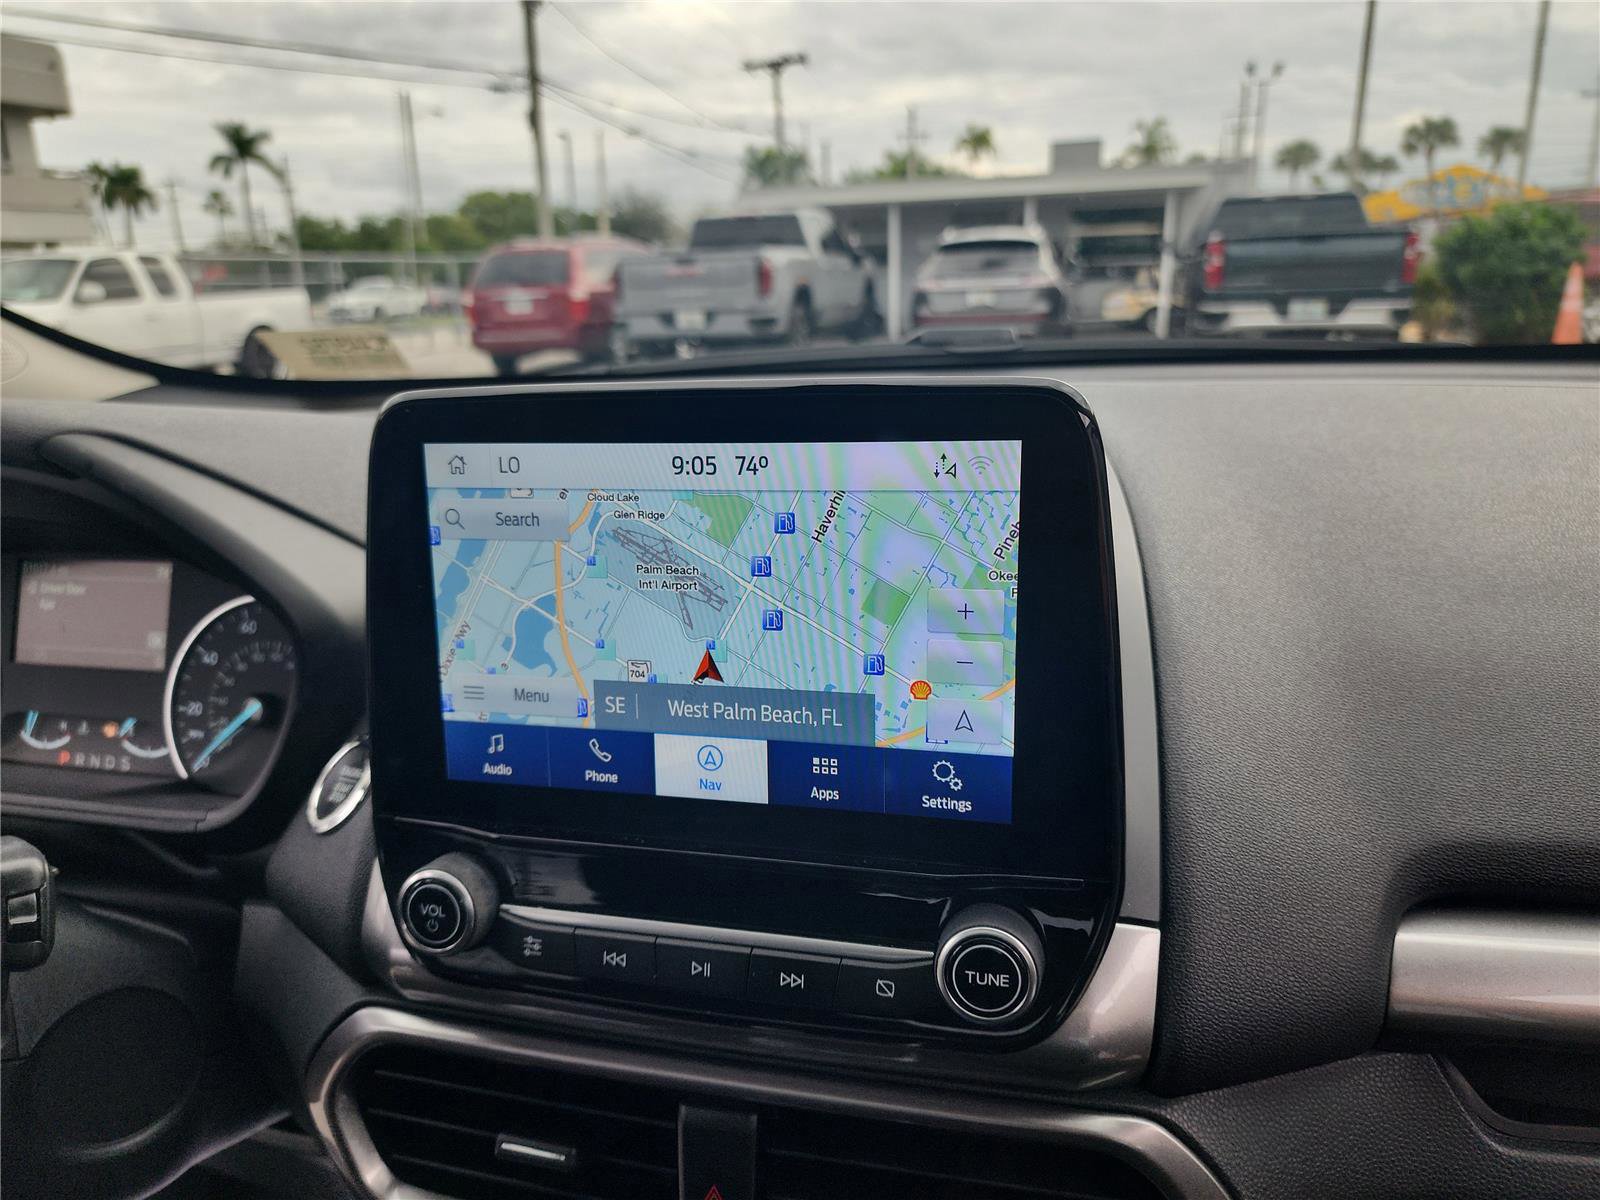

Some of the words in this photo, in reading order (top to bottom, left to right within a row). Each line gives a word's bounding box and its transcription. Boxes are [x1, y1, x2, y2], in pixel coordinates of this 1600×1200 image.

[498, 456, 521, 474] LO
[671, 455, 717, 476] 9:05
[587, 492, 615, 502] Cloud
[617, 492, 640, 502] Lake
[495, 512, 540, 527] Search
[613, 510, 636, 520] Glen
[637, 510, 666, 523] Ridge
[636, 564, 663, 576] Palm
[665, 564, 699, 576] Beach
[639, 579, 658, 590] Int'l
[661, 579, 698, 593] Airport
[629, 669, 646, 679] 704
[513, 687, 551, 703] Menu
[604, 695, 626, 715] SE
[667, 699, 710, 719] West
[713, 701, 757, 722] Palm
[760, 705, 818, 728] Beach,
[821, 708, 843, 727] FL
[482, 761, 513, 777] Audio
[584, 769, 619, 784] Phone
[699, 777, 722, 792] Nav
[809, 785, 840, 802] Apps
[921, 795, 973, 814] Settings
[420, 903, 446, 918] VOL
[964, 970, 1010, 988] TUNE
